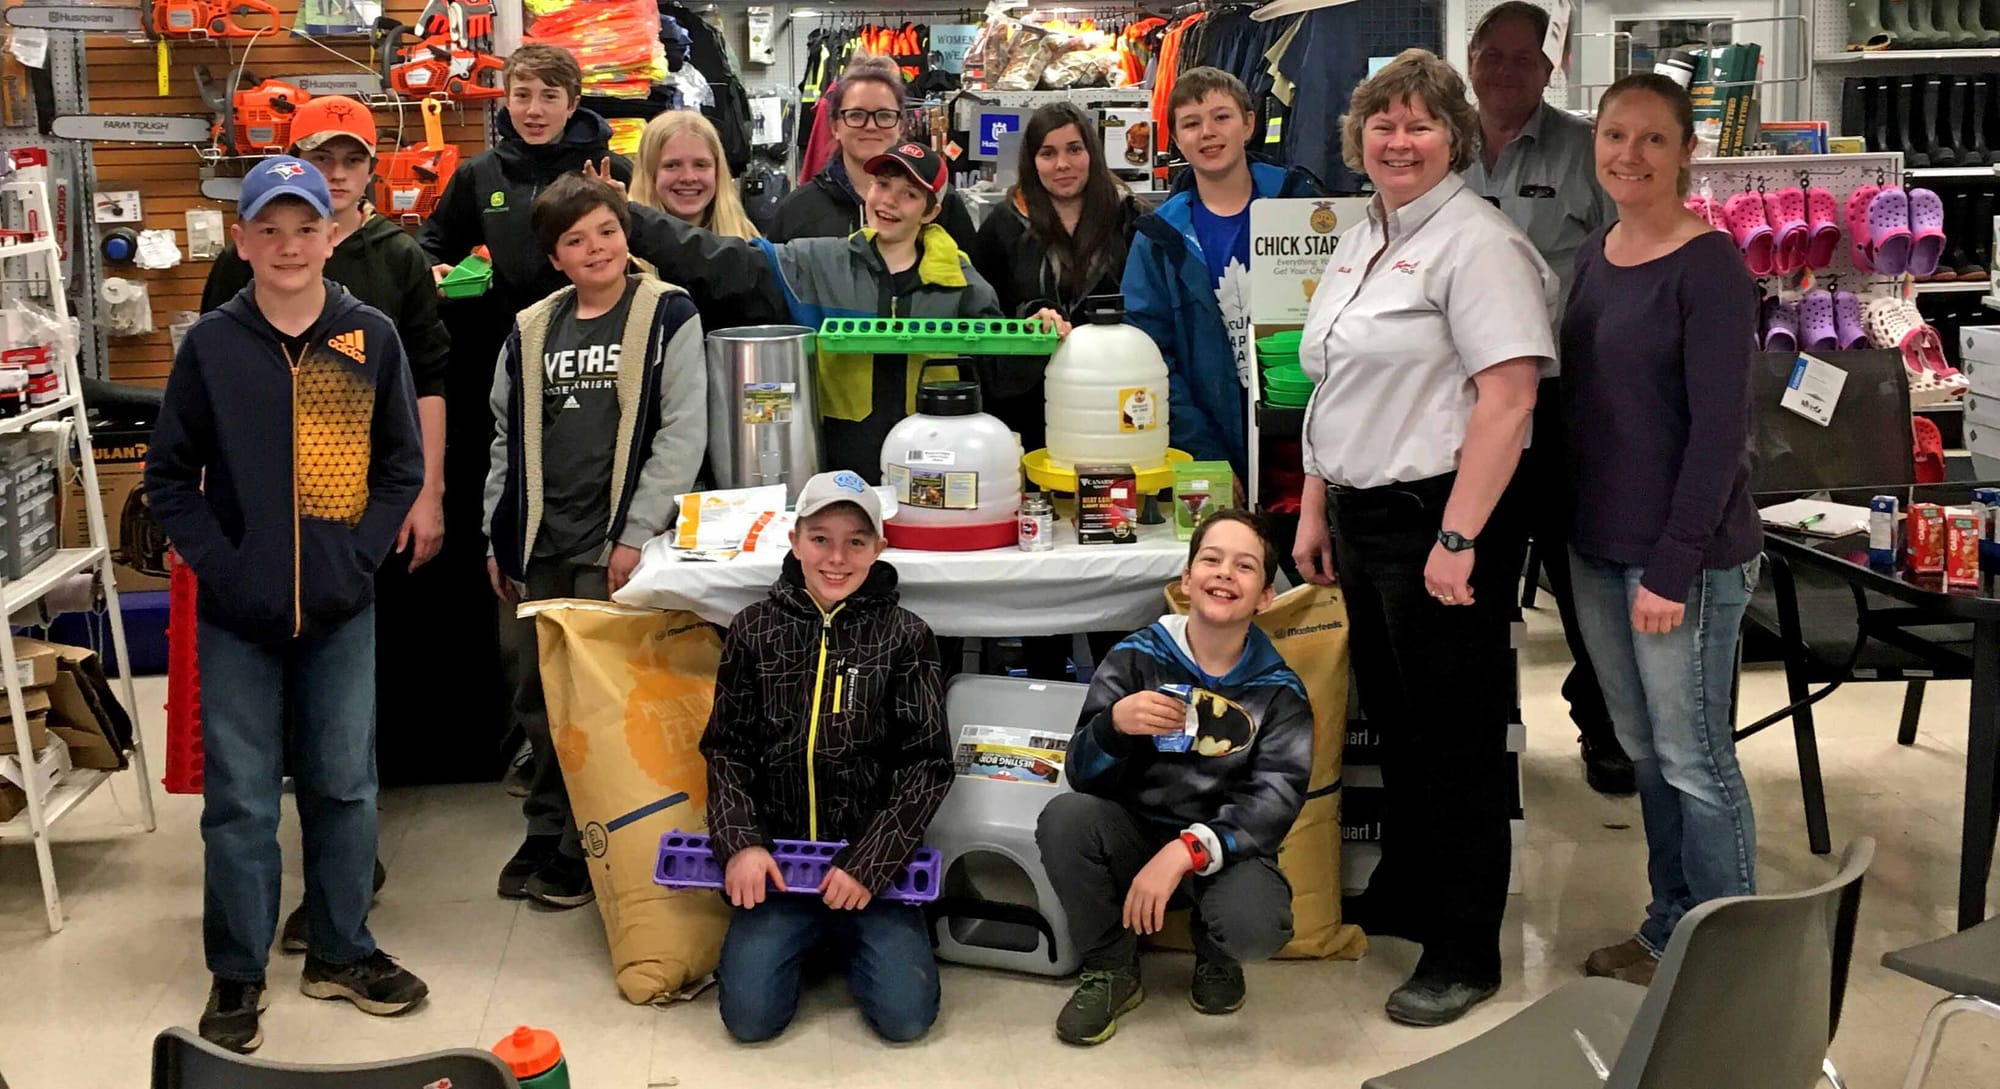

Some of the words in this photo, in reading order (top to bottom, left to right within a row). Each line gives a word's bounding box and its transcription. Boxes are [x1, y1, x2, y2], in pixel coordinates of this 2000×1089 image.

[60, 13, 113, 23] Husqvarna
[310, 80, 357, 89] Husqvarna
[103, 120, 130, 129] FARM
[133, 121, 168, 130] TOUGH
[1255, 236, 1300, 256] CHICK
[1304, 235, 1341, 256] STAR
[1277, 258, 1318, 267] Everything
[1273, 267, 1288, 275] Get
[1290, 267, 1308, 275] Your
[327, 338, 367, 365] adidas
[980, 756, 998, 764] BOX
[999, 757, 1036, 768] NESTING
